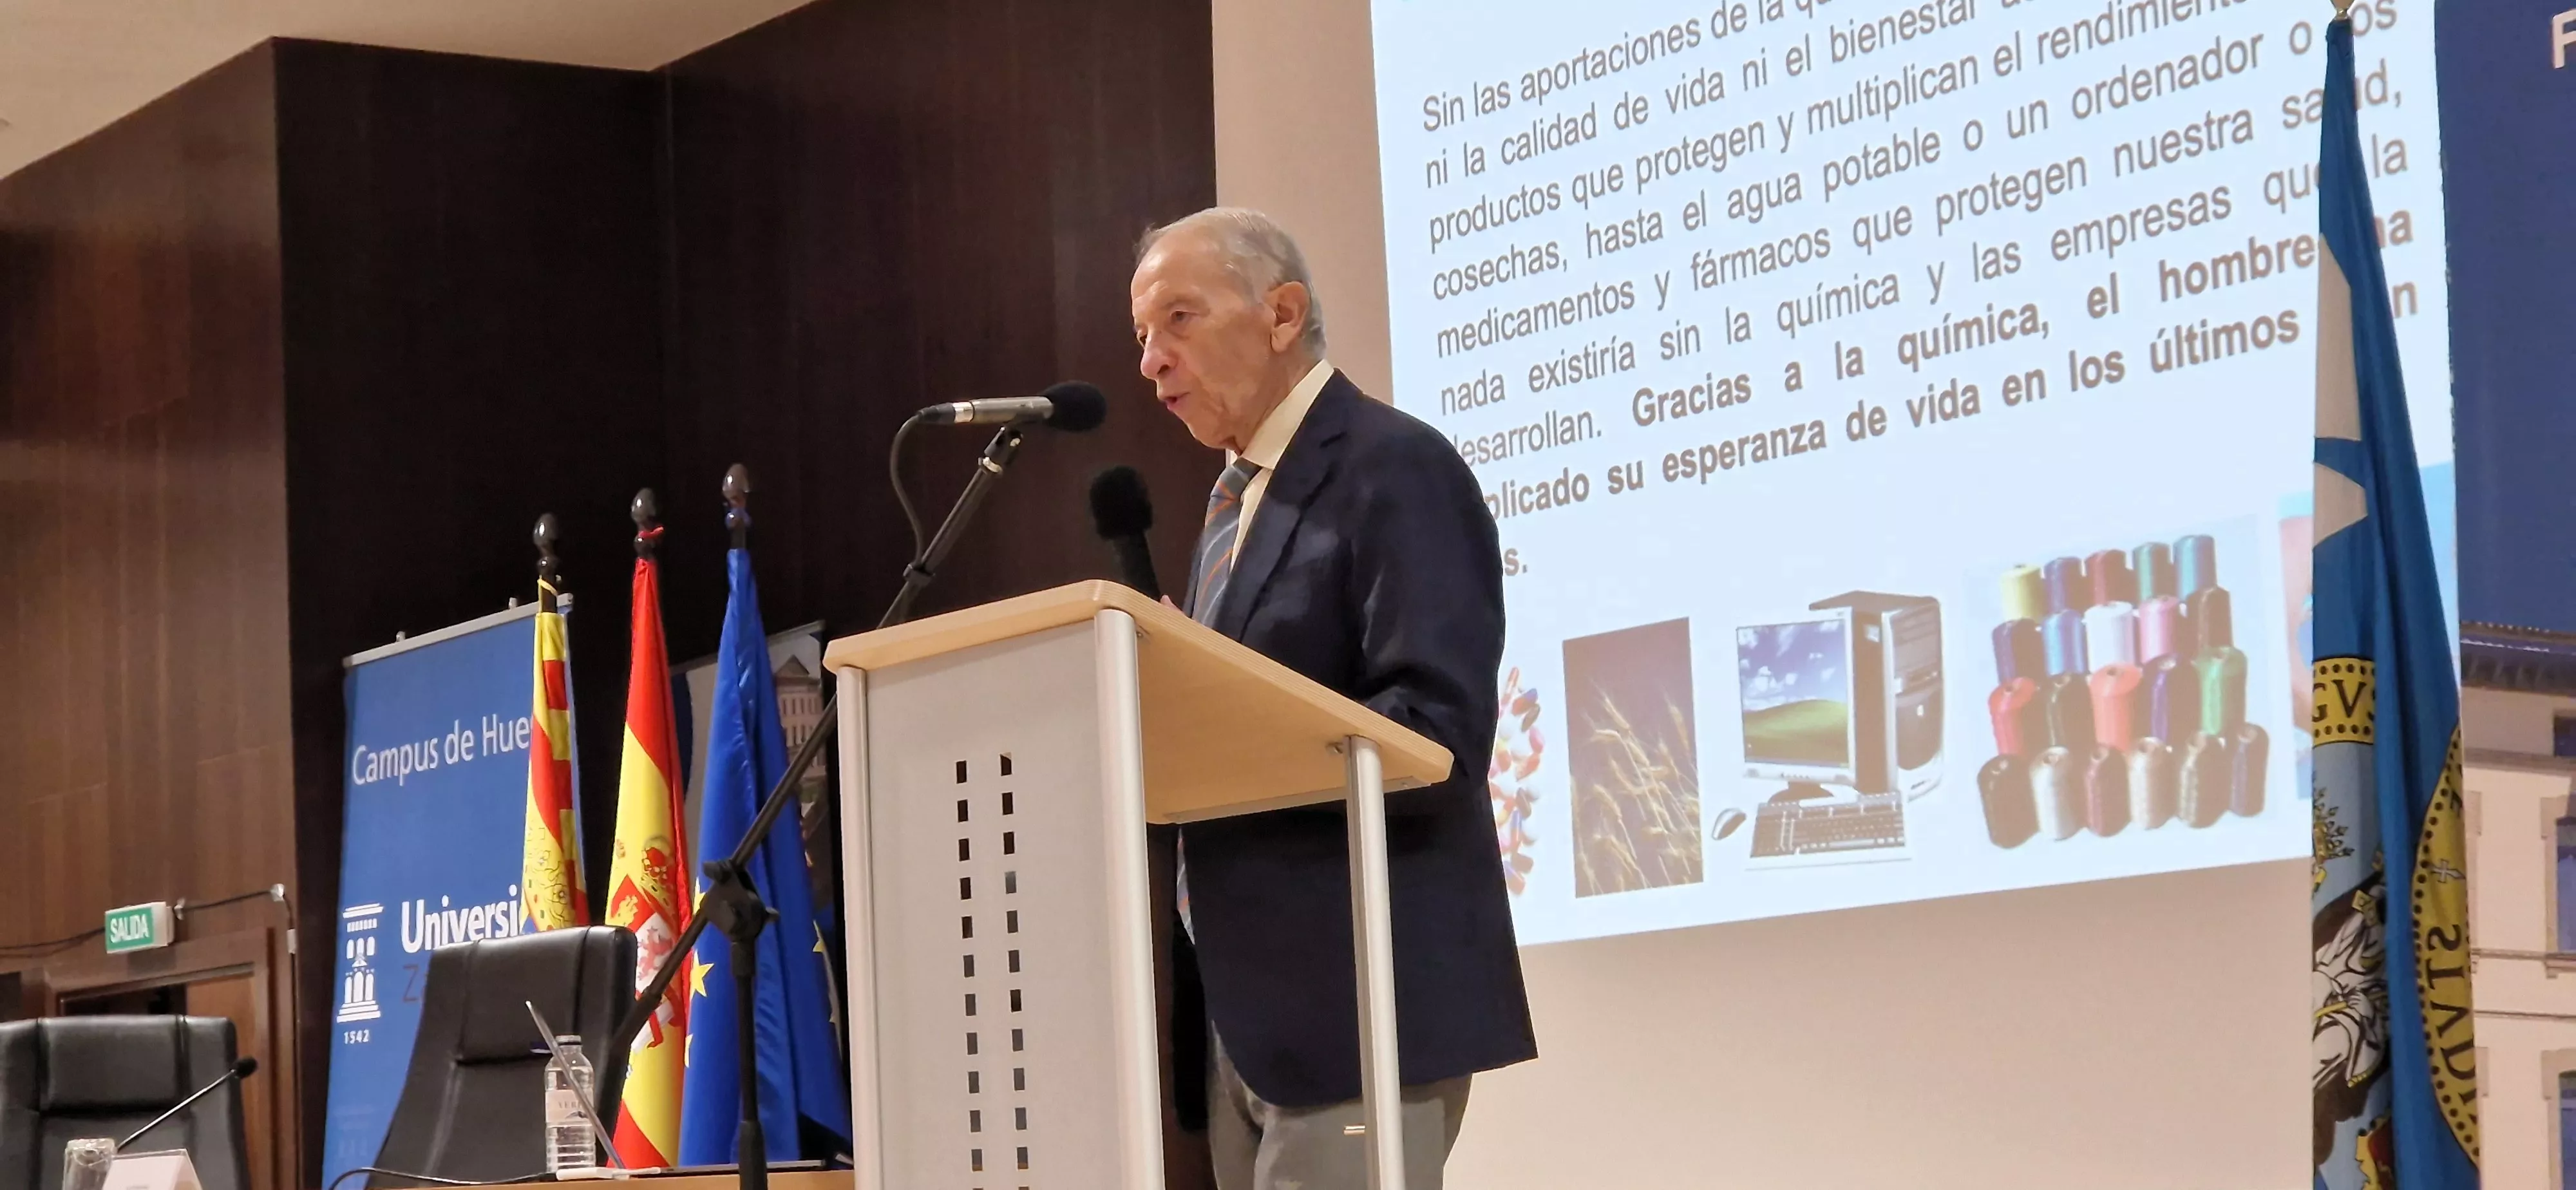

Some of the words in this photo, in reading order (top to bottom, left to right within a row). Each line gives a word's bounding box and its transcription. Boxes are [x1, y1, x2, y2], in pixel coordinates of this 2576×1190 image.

[1423, 91, 1464, 132] Sin
[1473, 81, 1511, 117] las
[1520, 19, 1701, 106] aportaciones
[1711, 0, 1747, 39] de
[1426, 148, 1448, 188] ni
[1464, 142, 1485, 177] la
[1501, 101, 1596, 165] calidad
[1614, 91, 1649, 130] de
[1665, 67, 1725, 114] vida
[1743, 47, 1767, 91] ni
[1786, 33, 1811, 77] el
[1430, 183, 1560, 254] productos
[1572, 164, 1624, 210] que
[1636, 122, 1765, 195] protegen
[1777, 111, 1794, 153] y
[1808, 56, 1978, 135] multiplican
[1993, 30, 2022, 77] el
[2037, 0, 2246, 64] rendimie
[1434, 241, 1567, 300] cosechas,
[1586, 209, 1663, 258] hasta
[1683, 189, 1707, 231] el
[1727, 173, 1802, 223] agua
[1824, 127, 1940, 203] potable
[1964, 120, 1983, 151] o
[2007, 100, 2048, 139] un
[2072, 34, 2264, 119] ordenador
[2289, 22, 2312, 55] o
[2351, 0, 2397, 37] os
[1437, 281, 1634, 358] medicamentos
[1654, 270, 1670, 311] y
[1690, 229, 1830, 291] fármacos
[1853, 206, 1912, 256] que
[1937, 156, 2087, 236] protegen
[2114, 109, 2253, 177] nuestra
[2282, 58, 2401, 129] sad,
[1441, 369, 1505, 416] nada
[1528, 335, 1635, 392] existiría
[1660, 319, 1701, 360] sin
[1725, 307, 1752, 345] la
[1777, 273, 1899, 339] química
[1927, 261, 1944, 305] y
[1973, 242, 2021, 282] las
[2051, 186, 2231, 261] empresas
[2264, 164, 2320, 214] qu
[2372, 133, 2408, 178] la
[1607, 460, 1643, 495] su
[1662, 420, 1826, 485] esperanza
[1846, 400, 1887, 442] de
[1906, 378, 1980, 428] vida
[2002, 369, 2046, 406] en
[2069, 350, 2125, 392] los
[2150, 310, 2299, 373] últimos
[1633, 372, 1751, 426] Gracias
[1785, 362, 1803, 392] a
[1835, 341, 1864, 380] la
[1898, 303, 2049, 373] química,
[2087, 272, 2119, 319] el
[2159, 234, 2315, 302] hombre
[353, 737, 439, 786] Campus
[444, 719, 474, 764] de
[482, 713, 534, 757] Hue
[110, 914, 149, 943] SALIDA
[401, 884, 519, 953] Universi
[344, 1029, 370, 1044] 1542
